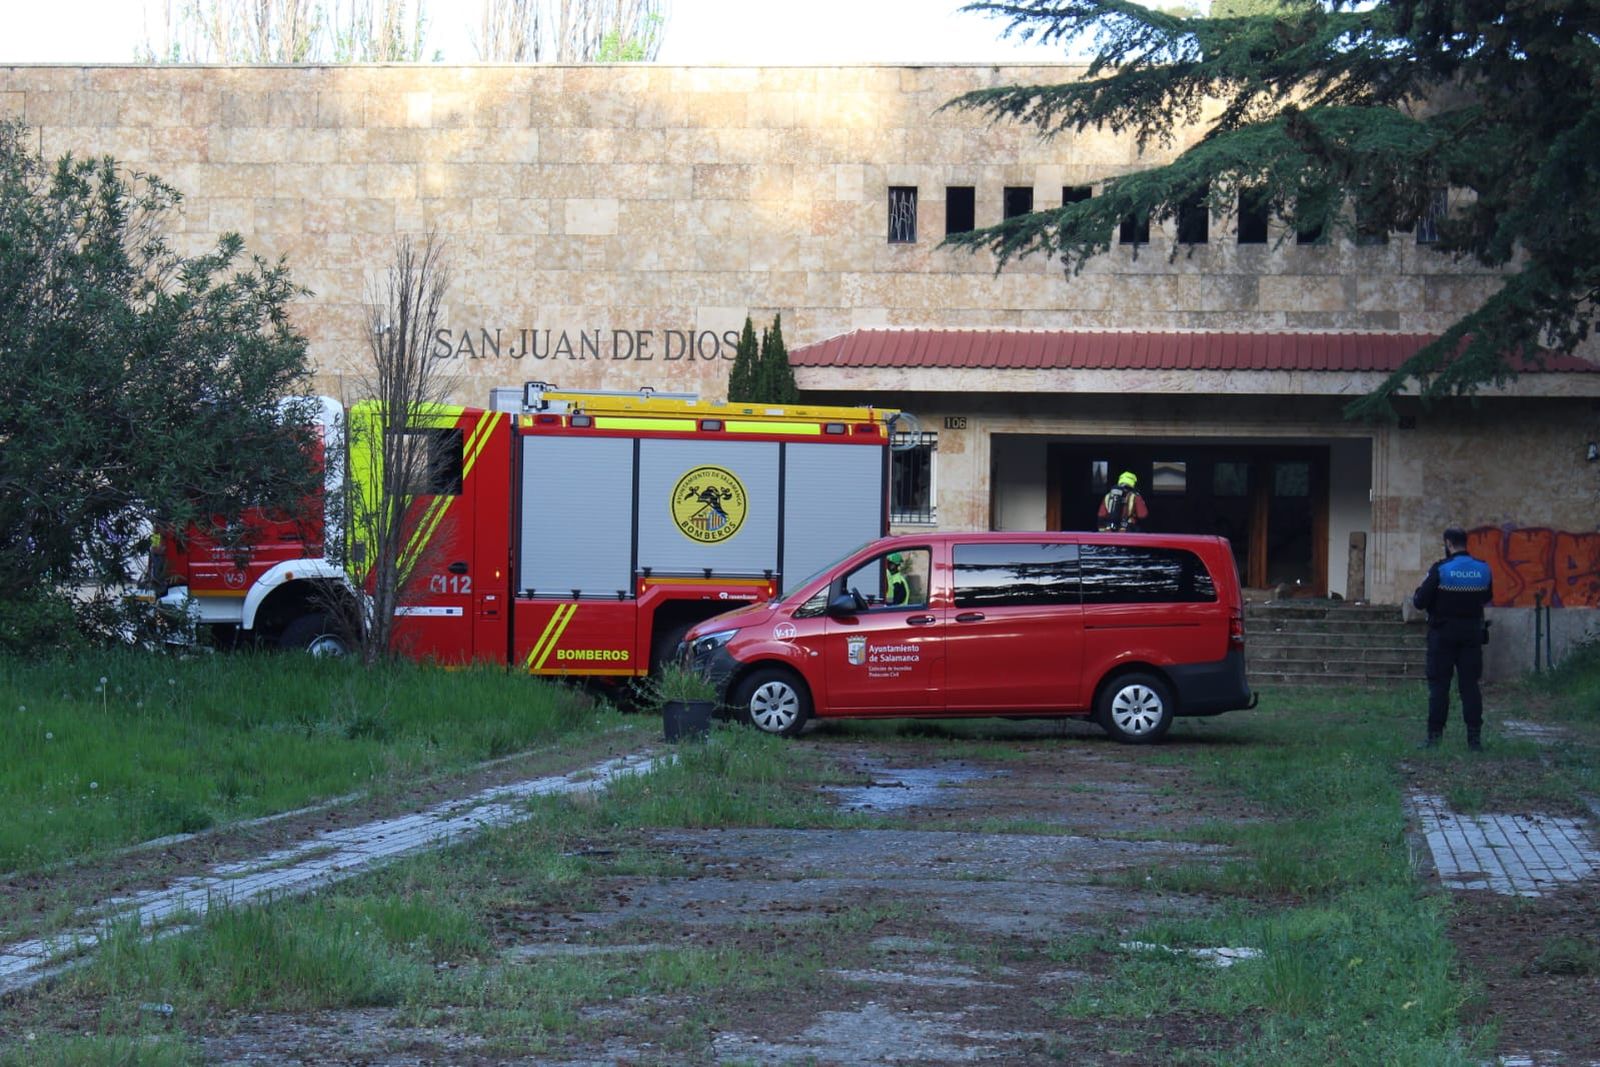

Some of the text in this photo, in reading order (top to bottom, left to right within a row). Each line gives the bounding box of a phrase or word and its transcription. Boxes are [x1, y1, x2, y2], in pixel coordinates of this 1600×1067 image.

[433, 328, 740, 361] SAN JUAN DE DIOS
[946, 417, 966, 428] 106
[681, 520, 737, 540] BOMBEROS
[226, 573, 244, 583] V-3
[439, 575, 472, 593] 112
[775, 628, 795, 638] V-17
[869, 644, 919, 654] Ayuntamiento
[556, 649, 629, 661] BOMBEROS
[869, 654, 920, 662] de Salamanca
